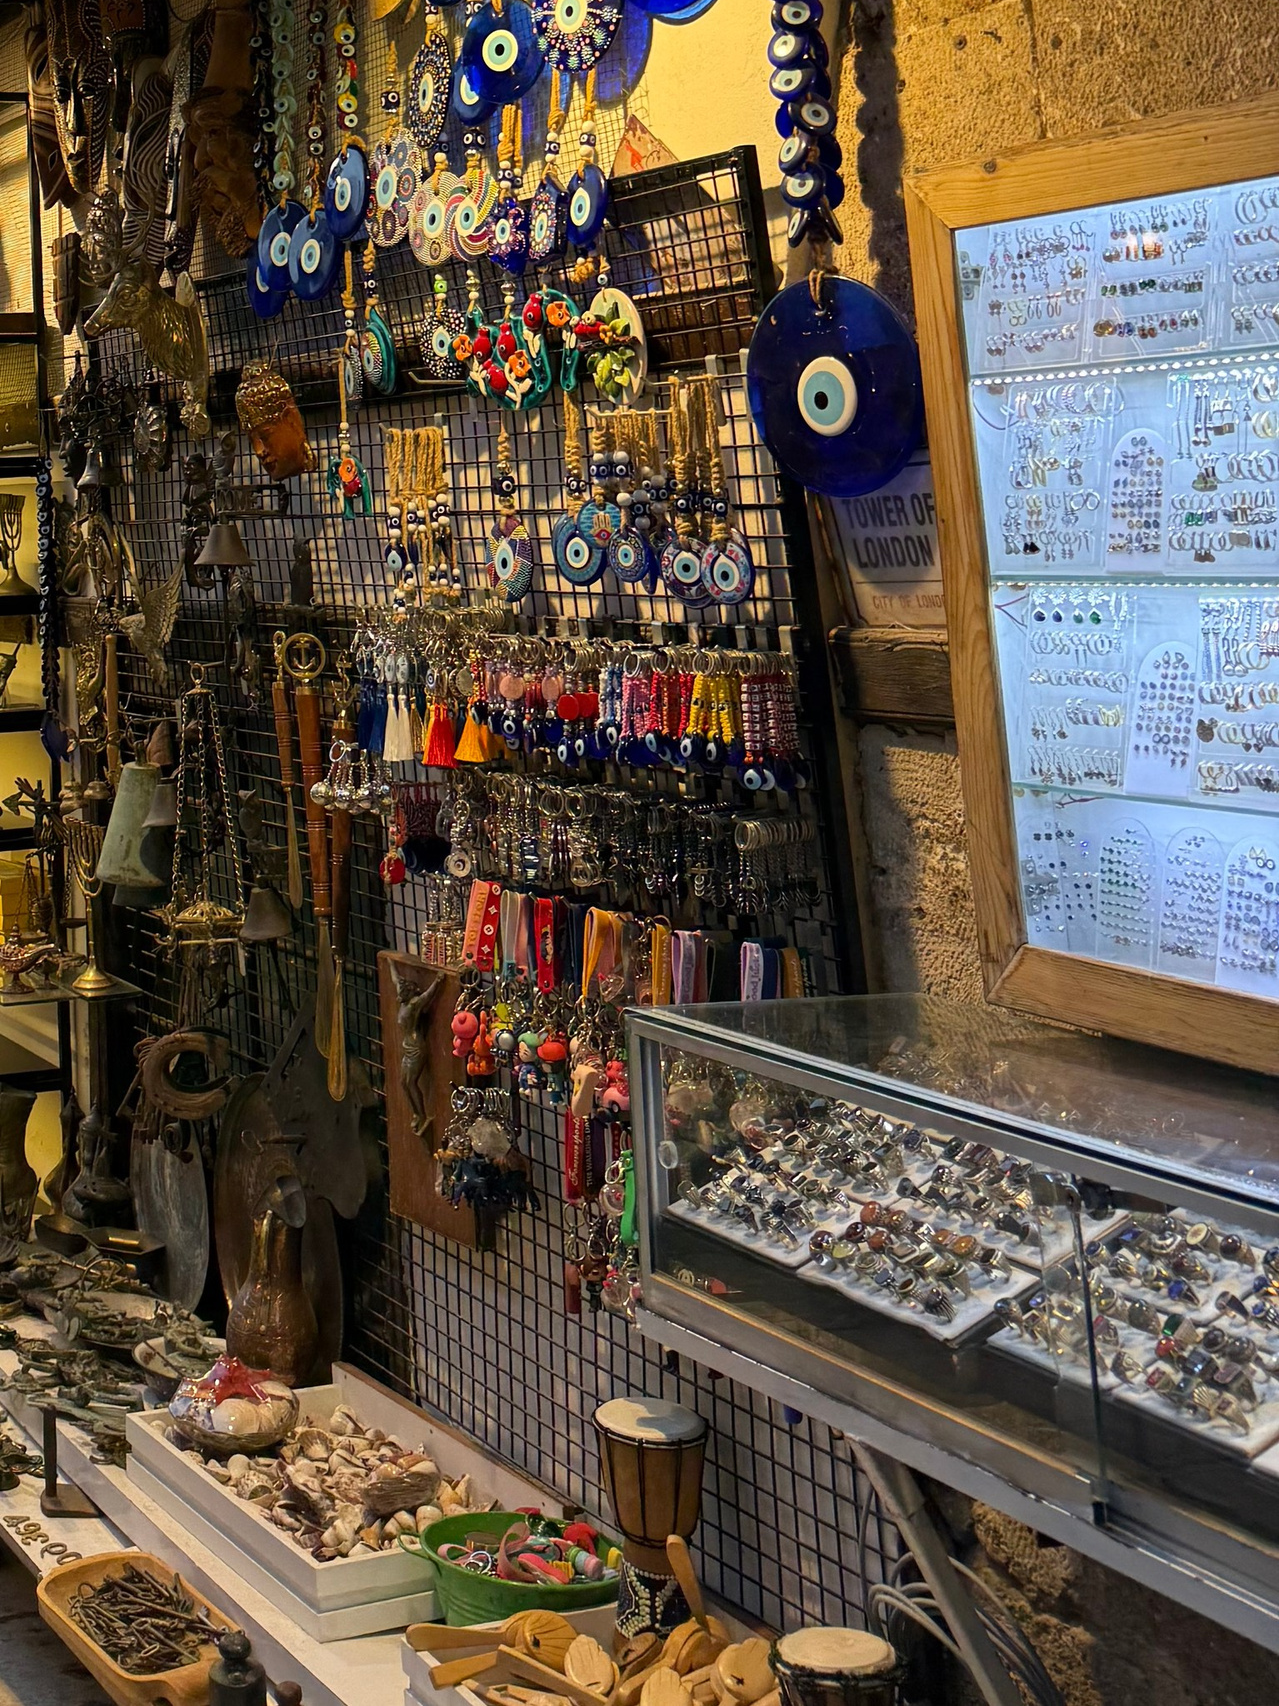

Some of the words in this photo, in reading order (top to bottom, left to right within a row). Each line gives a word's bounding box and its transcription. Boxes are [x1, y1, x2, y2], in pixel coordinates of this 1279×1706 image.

[842, 495, 911, 530] TOWER
[913, 493, 935, 526] OF
[853, 534, 935, 568] LONDON
[873, 595, 894, 610] CITY
[899, 595, 912, 609] OF
[584, 1135, 593, 1171] WALKING
